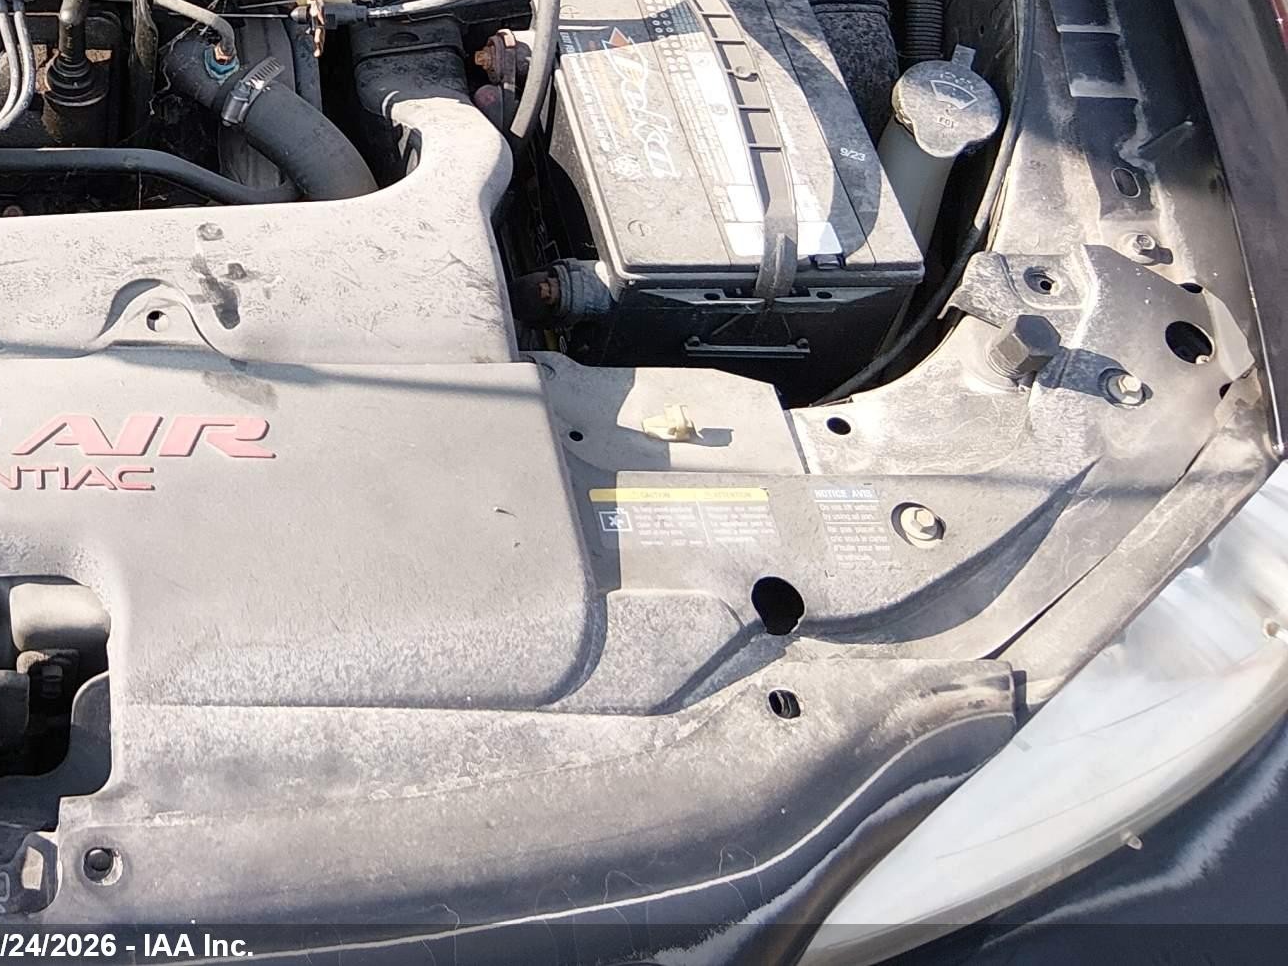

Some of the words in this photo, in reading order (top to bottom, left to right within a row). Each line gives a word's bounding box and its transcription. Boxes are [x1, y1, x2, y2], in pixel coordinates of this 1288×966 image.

[839, 147, 866, 162] 9/23
[12, 414, 278, 459] AIR
[814, 489, 848, 498] NOTICE
